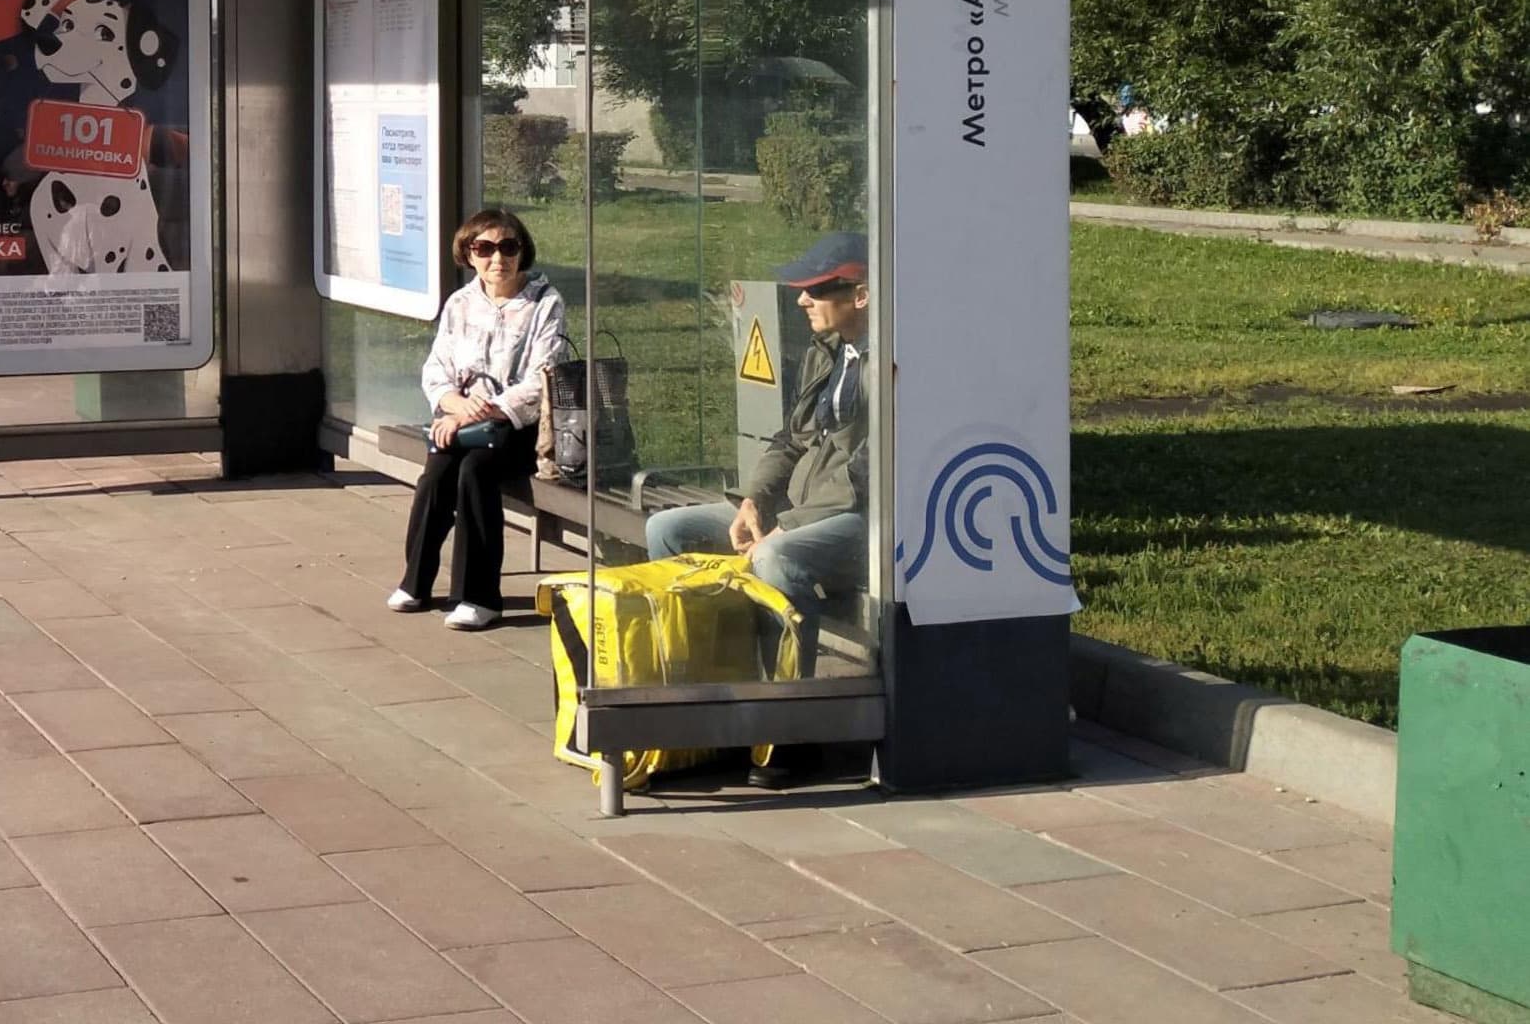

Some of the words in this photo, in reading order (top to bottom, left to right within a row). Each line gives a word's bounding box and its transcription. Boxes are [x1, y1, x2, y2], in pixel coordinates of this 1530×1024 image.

[961, 35, 990, 147] Метро
[59, 113, 114, 146] 101
[35, 143, 133, 166] ПЛАНИРОВКА
